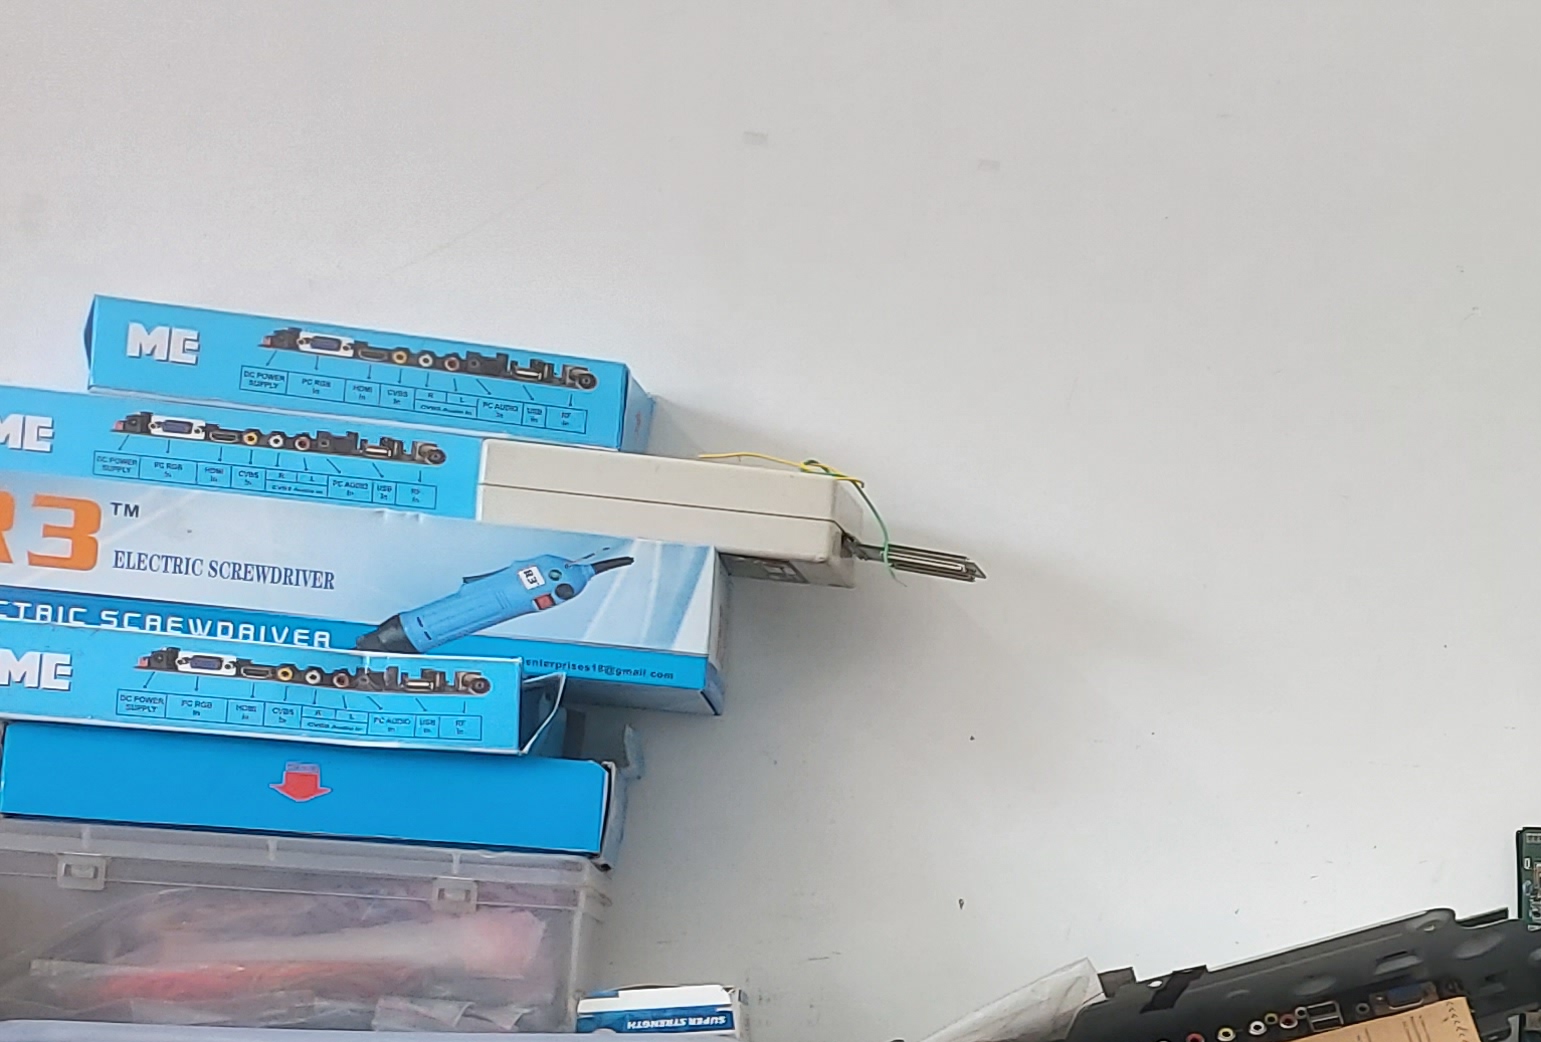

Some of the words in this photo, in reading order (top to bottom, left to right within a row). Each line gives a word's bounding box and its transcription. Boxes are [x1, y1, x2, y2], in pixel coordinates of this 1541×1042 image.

[126, 320, 200, 365] ME
[0, 490, 102, 572] 3
[112, 550, 204, 577] ELECTRIC
[207, 559, 336, 591] SCREWDRIVER
[100, 610, 332, 649] SCREWDRIVER
[0, 648, 74, 692] ME
[626, 1018, 687, 1030] STRENGTH
[687, 1014, 727, 1026] SUPER
